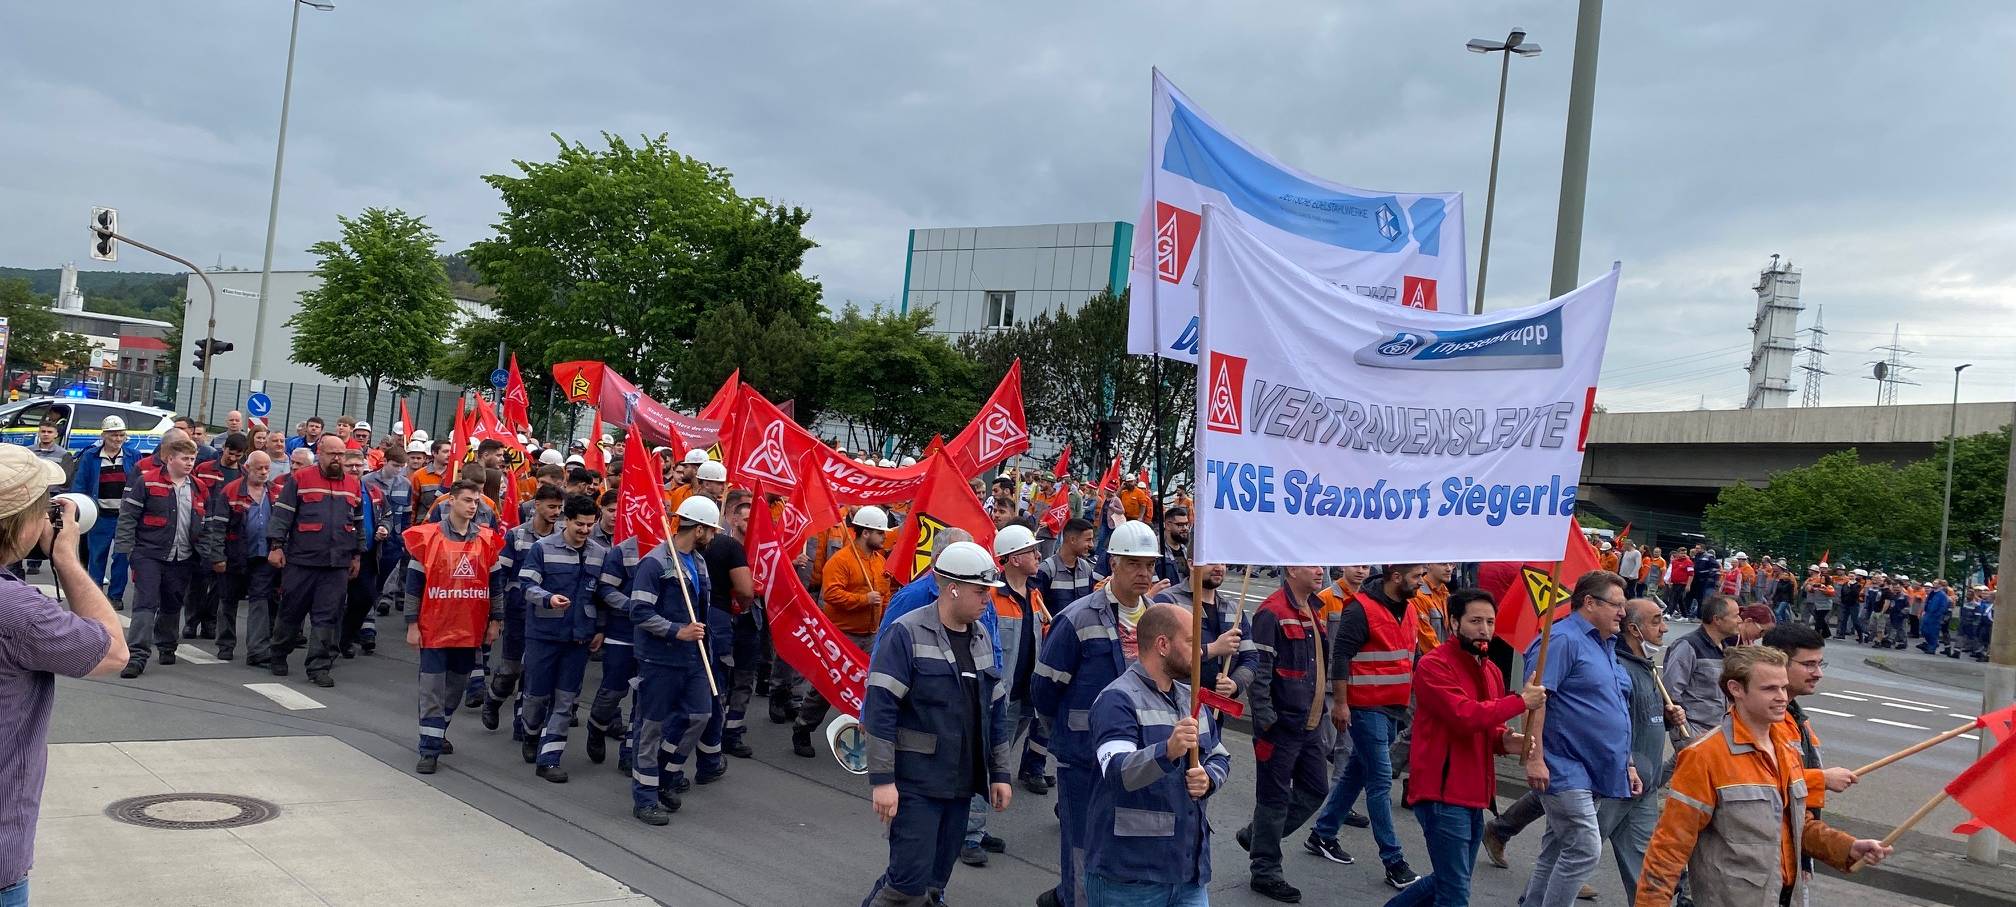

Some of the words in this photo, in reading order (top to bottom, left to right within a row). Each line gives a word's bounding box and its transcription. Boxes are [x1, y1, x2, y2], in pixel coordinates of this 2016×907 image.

[1210, 372, 1235, 425] IGM
[1249, 379, 1575, 456] VERTRAUENSLEUTE
[1283, 469, 1432, 520] Standort
